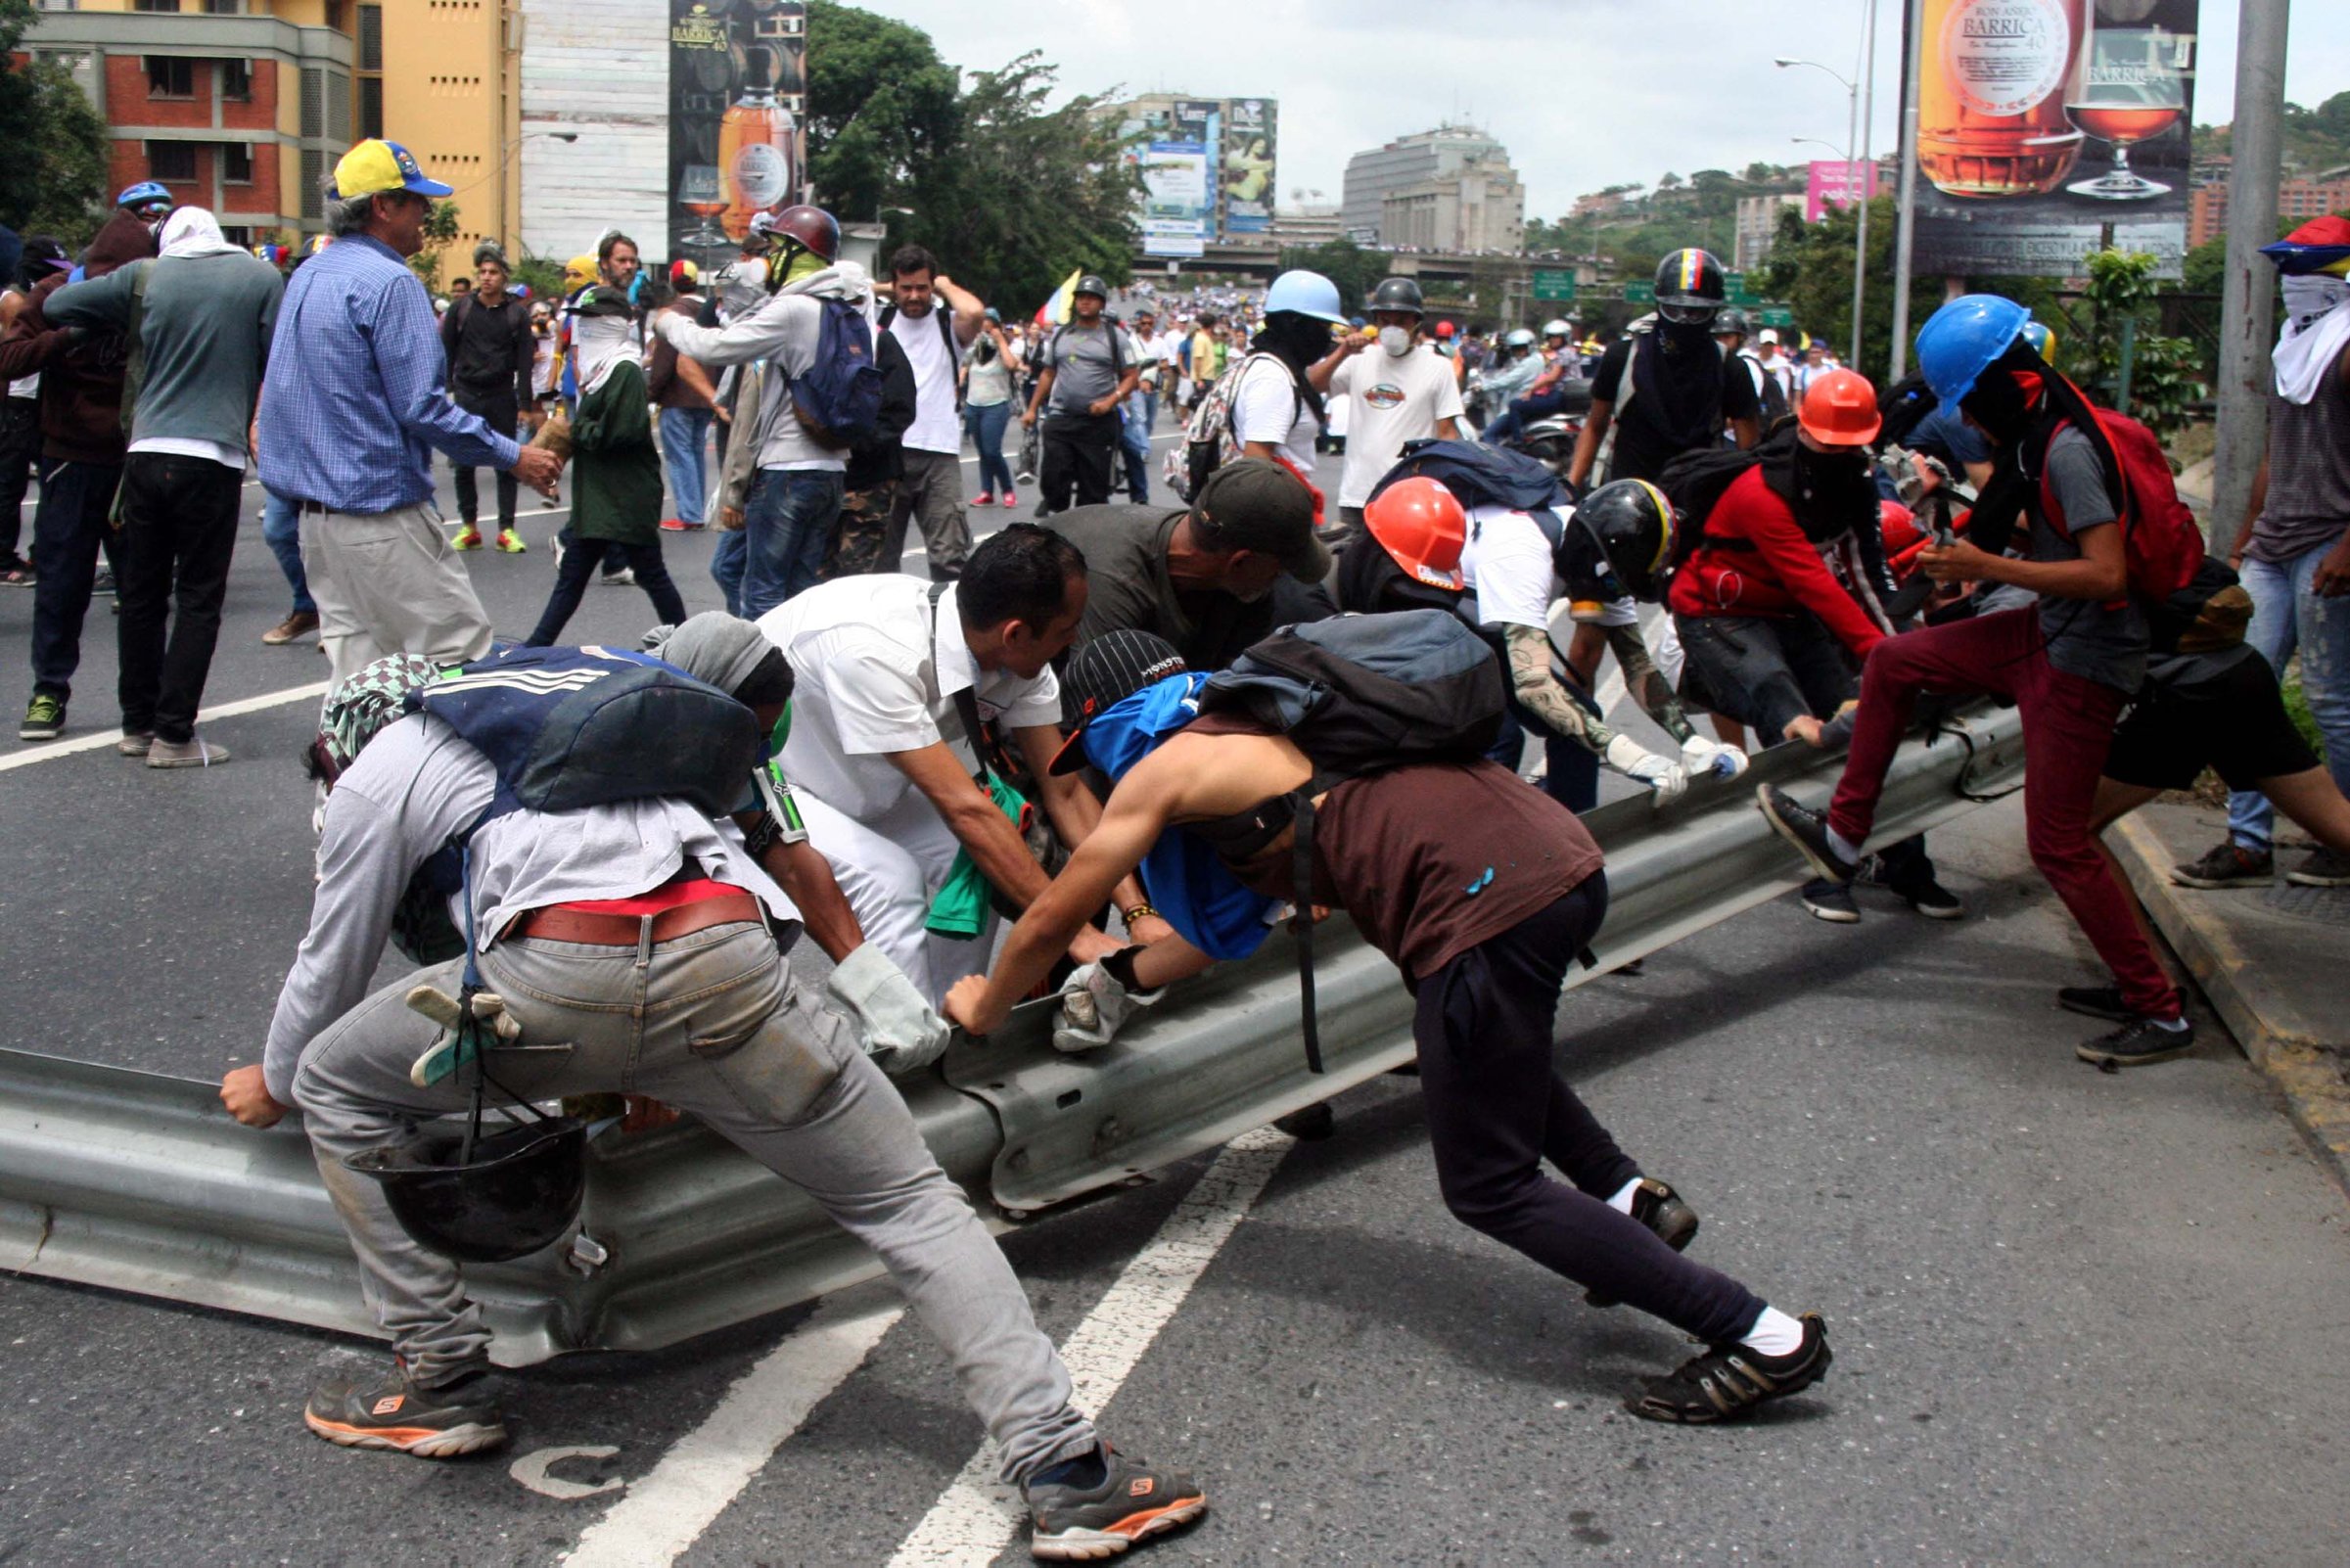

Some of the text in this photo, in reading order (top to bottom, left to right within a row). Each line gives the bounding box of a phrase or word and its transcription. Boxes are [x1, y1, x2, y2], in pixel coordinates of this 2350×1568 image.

[672, 26, 725, 41] BARRICA
[1962, 18, 2046, 35] BARRICA
[2089, 66, 2167, 82] BARRICA
